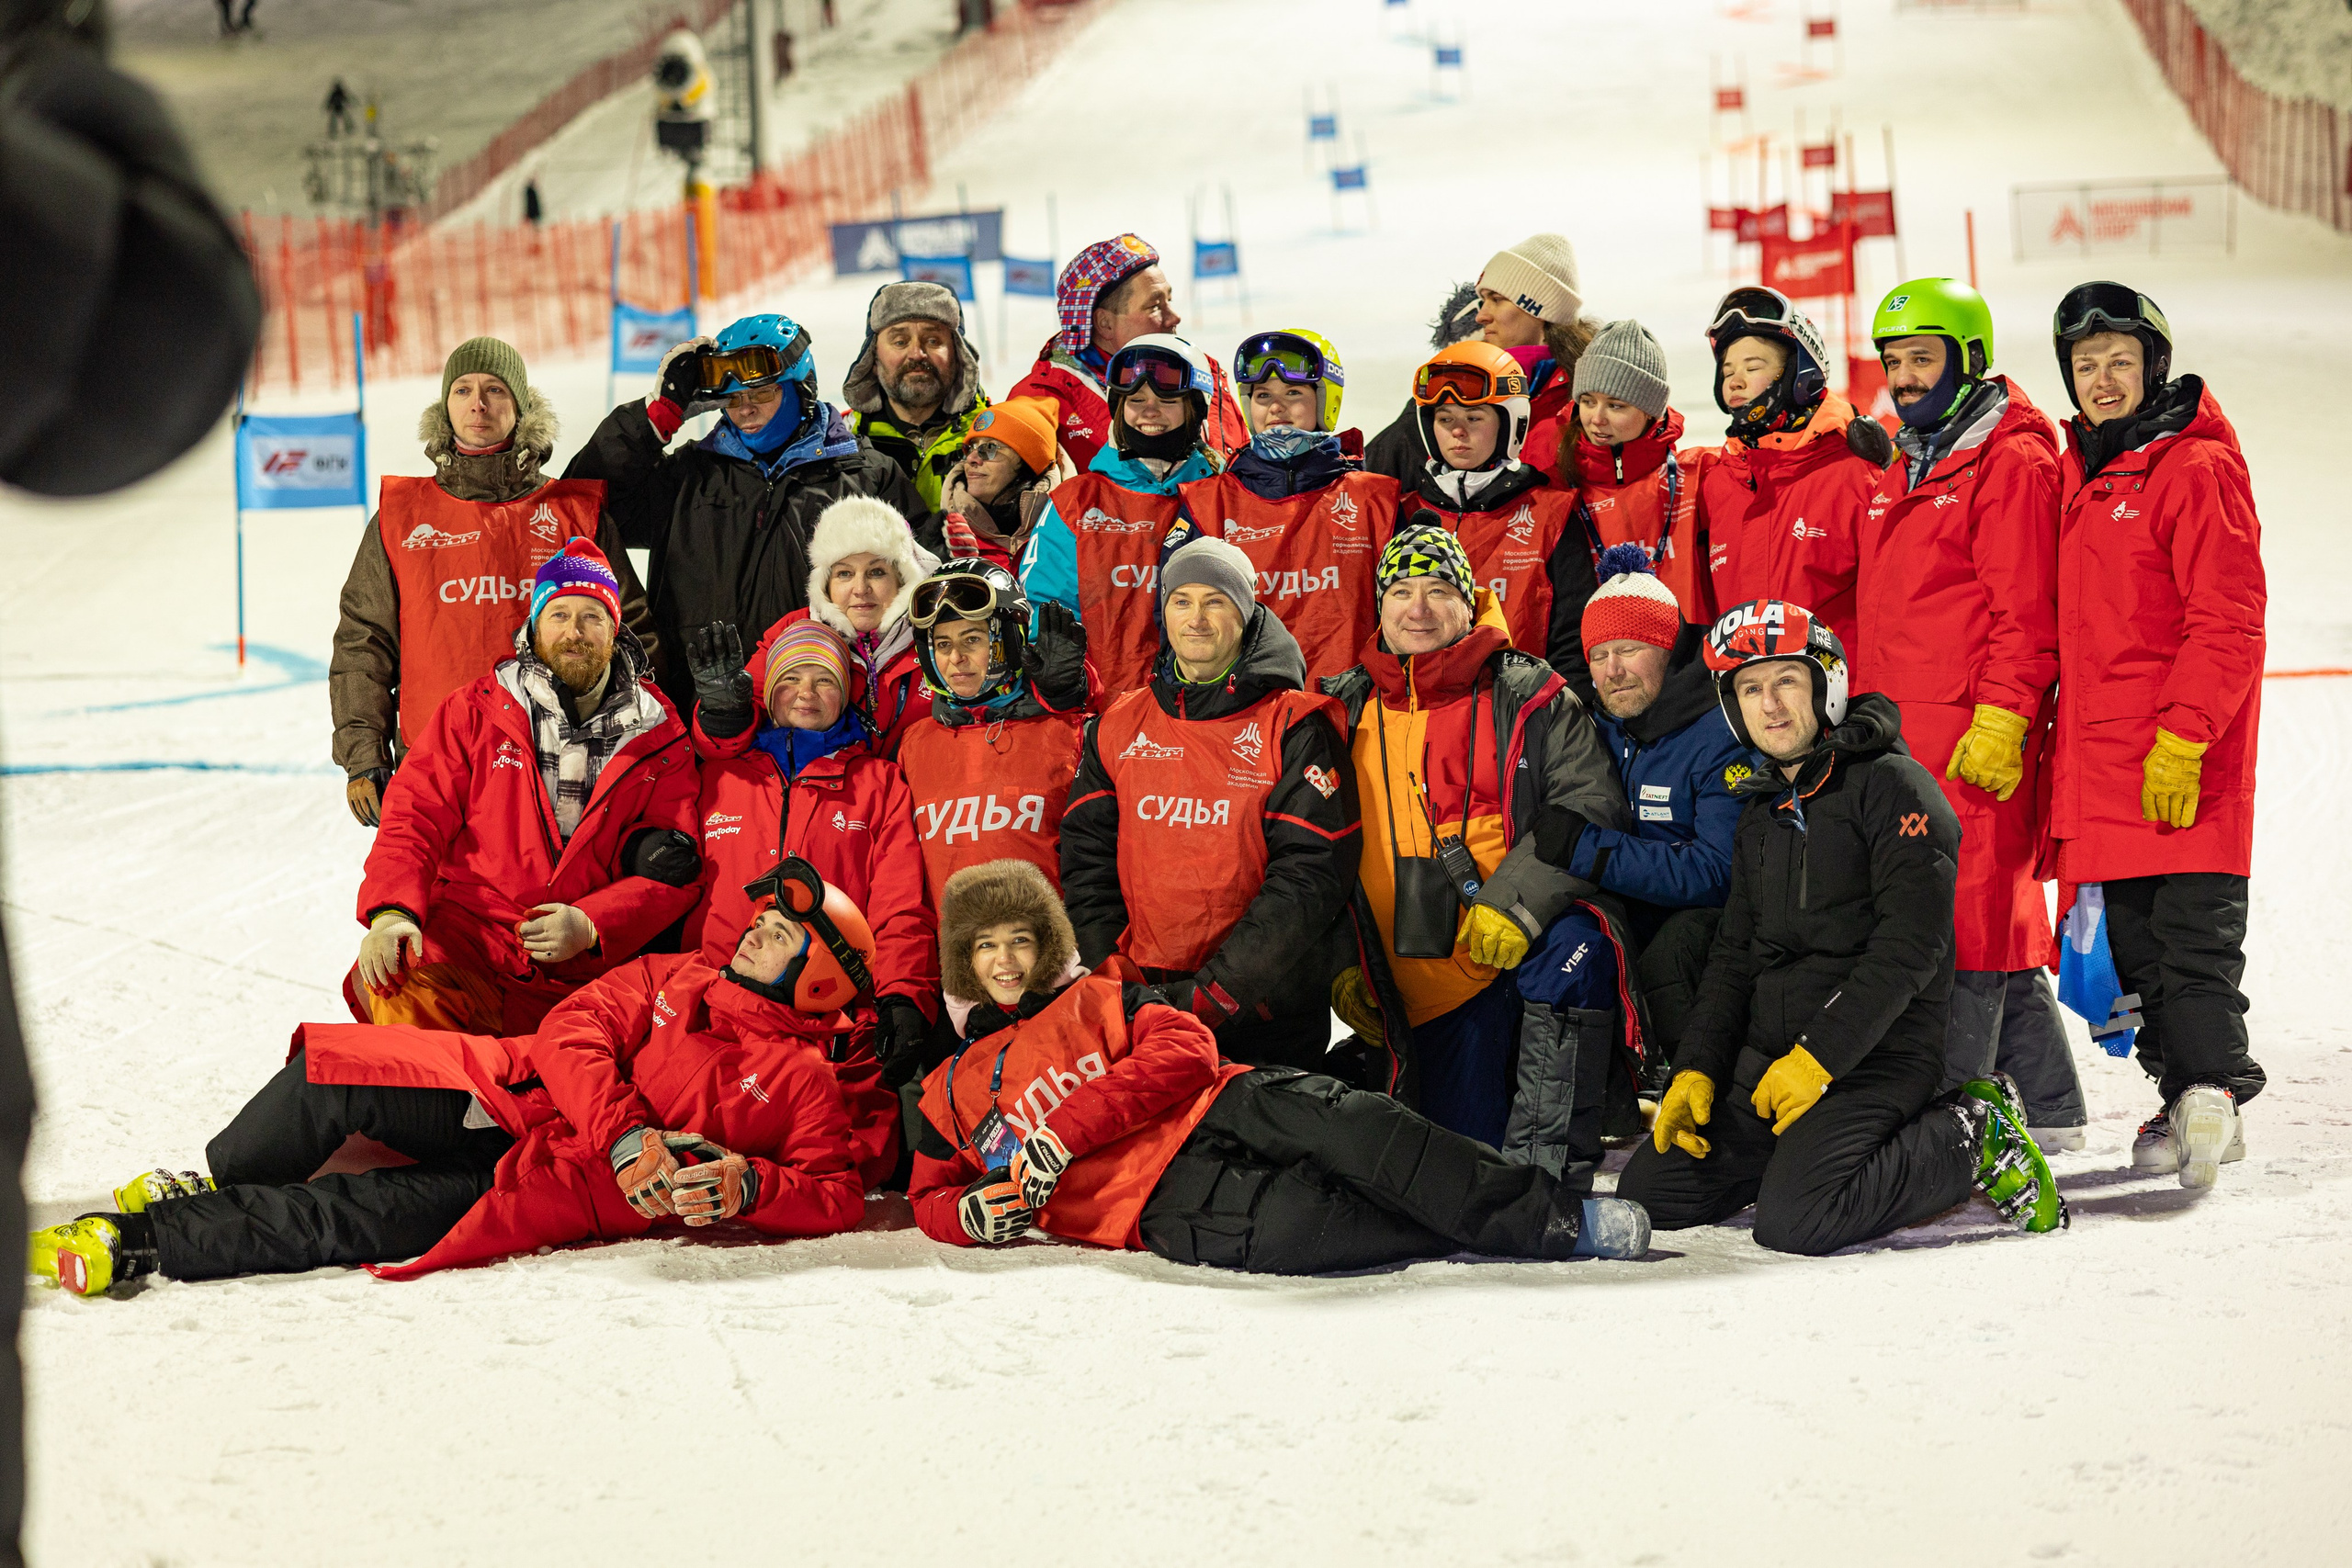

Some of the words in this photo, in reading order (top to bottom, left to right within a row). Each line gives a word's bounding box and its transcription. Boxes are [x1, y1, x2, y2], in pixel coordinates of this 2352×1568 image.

[1797, 324, 1824, 361] SHRED
[1196, 371, 1212, 386] poc
[439, 576, 535, 605] СУДЬЯ
[561, 581, 596, 589] SKI
[1711, 604, 1784, 649] VOLA
[1725, 627, 1765, 647] RACING
[1227, 773, 1274, 786] горнолыжная
[1229, 766, 1267, 777] Московская
[1227, 780, 1259, 790] академия
[1136, 795, 1230, 829] СУДЬЯ
[1004, 1052, 1107, 1144] УДЬЯ
[1040, 1145, 1060, 1170] reusch
[679, 1168, 708, 1179] reusch
